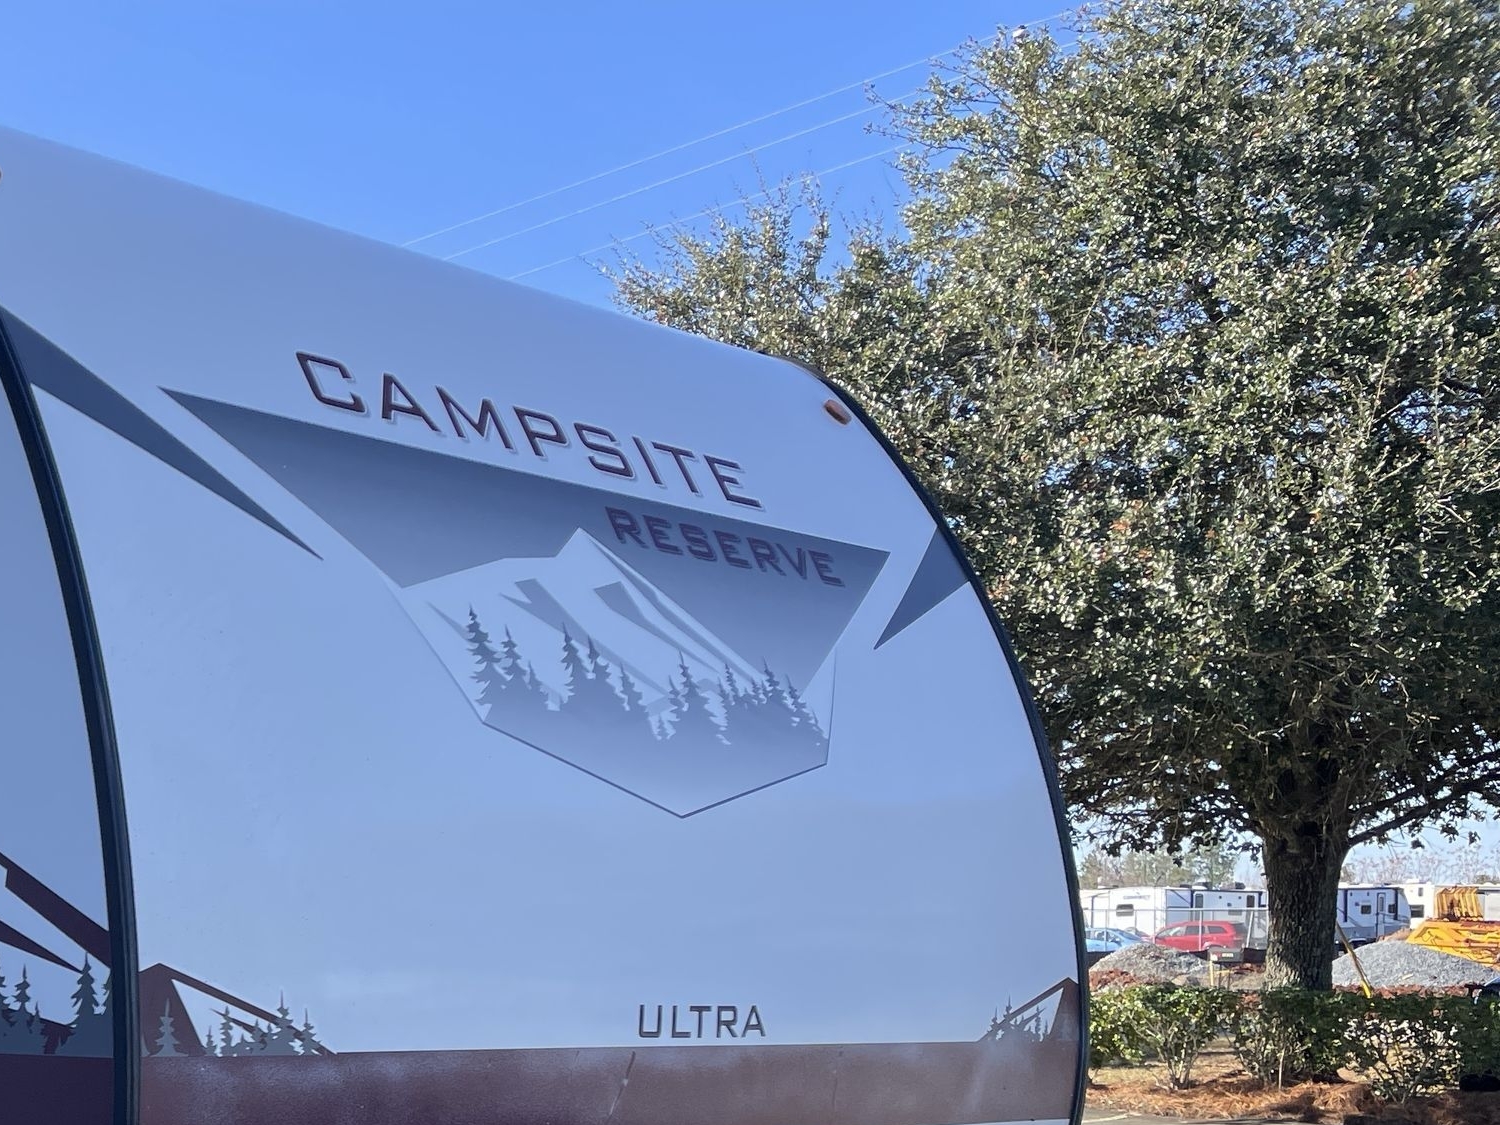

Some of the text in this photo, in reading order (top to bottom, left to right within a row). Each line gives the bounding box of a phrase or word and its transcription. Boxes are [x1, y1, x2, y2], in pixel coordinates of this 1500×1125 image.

[295, 350, 765, 510] CAMPSITE
[605, 505, 846, 588] RESERVE
[638, 1004, 766, 1039] ULTRA
